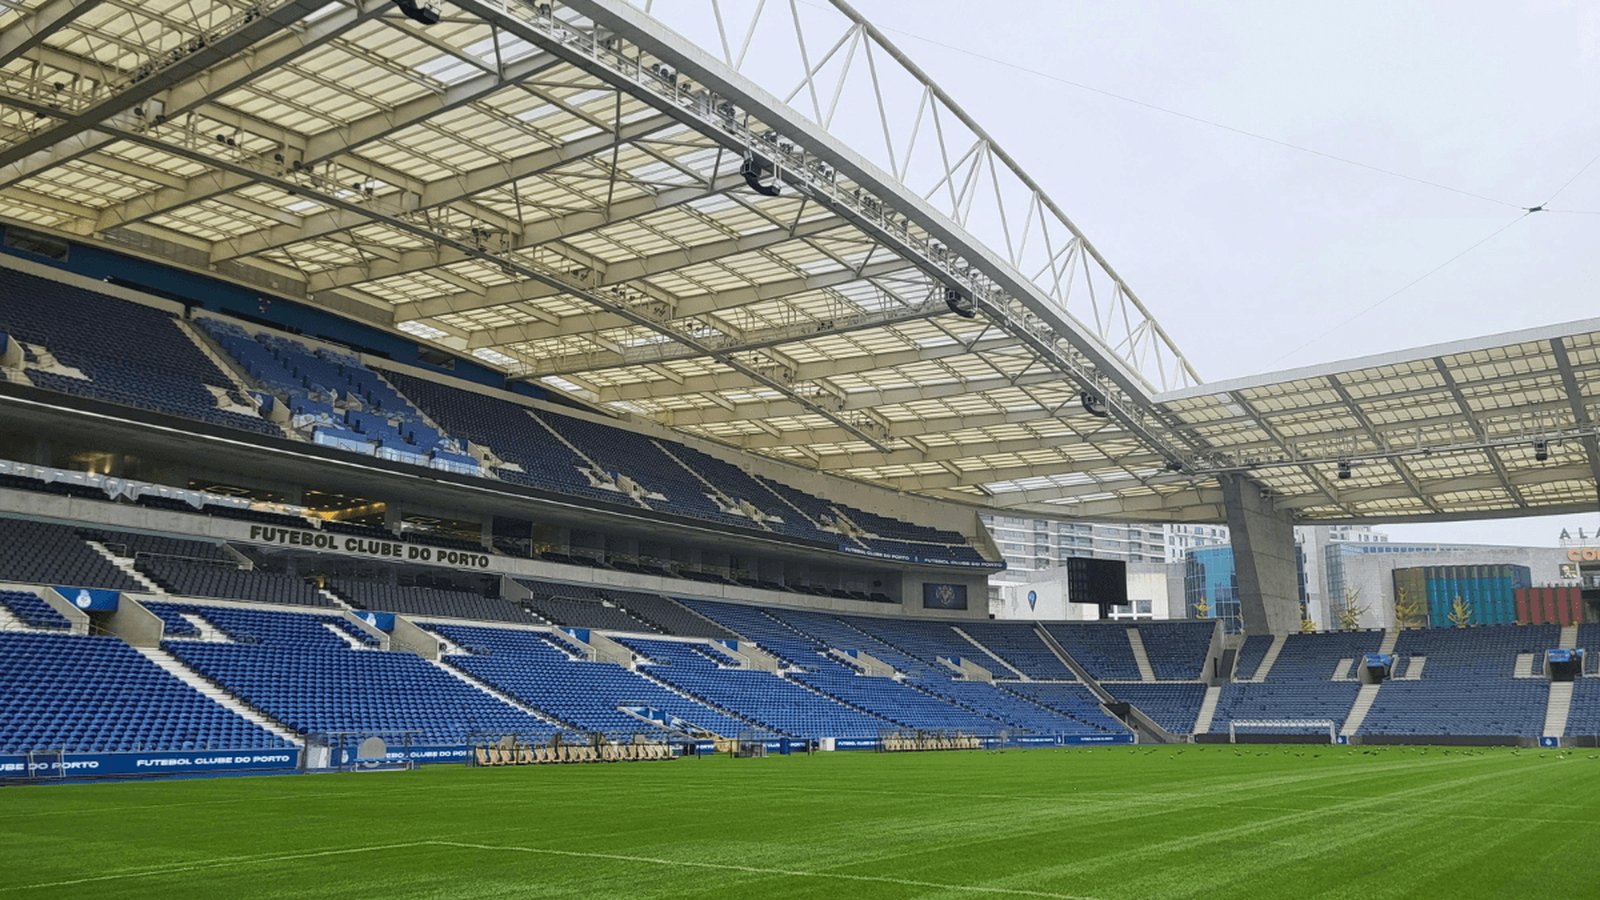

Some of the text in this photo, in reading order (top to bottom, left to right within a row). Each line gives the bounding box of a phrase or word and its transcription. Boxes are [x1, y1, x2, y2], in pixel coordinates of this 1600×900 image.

[250, 525, 489, 568] FUTEBOL CLUBE DO PORTO
[1567, 548, 1600, 561] CO
[28, 762, 49, 770] DO
[52, 761, 99, 769] PORTO
[136, 755, 290, 767] FUTEBOL CLUBE DO PORTO
